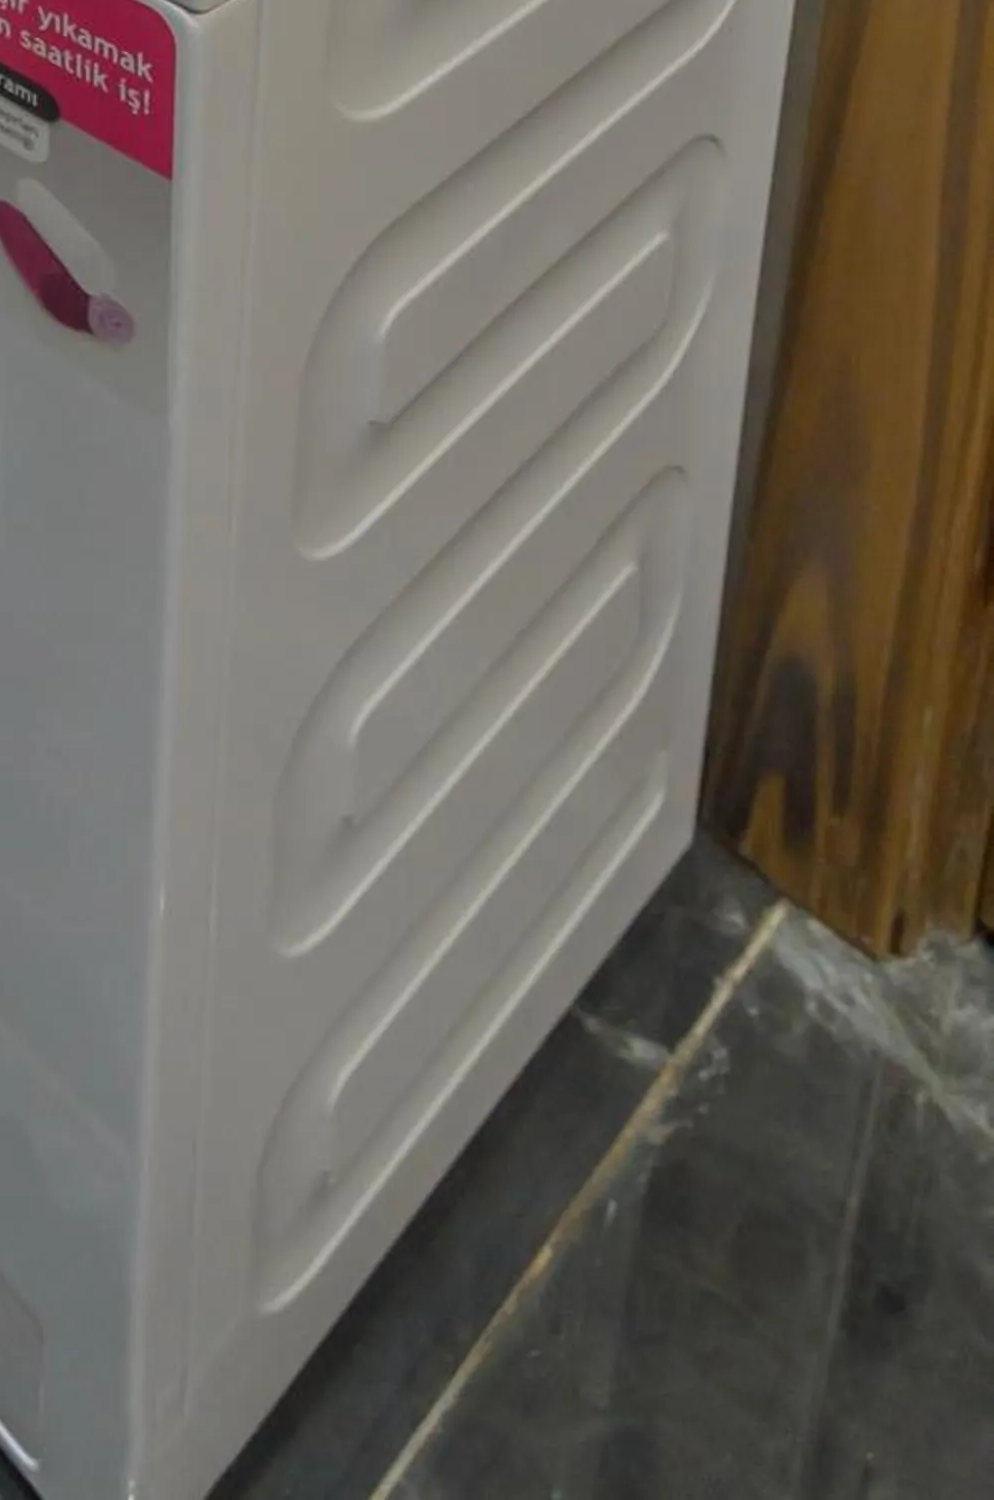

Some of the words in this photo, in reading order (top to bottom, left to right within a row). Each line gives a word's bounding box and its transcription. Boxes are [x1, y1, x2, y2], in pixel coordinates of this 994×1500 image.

[19, 29, 109, 92] saatlik
[118, 77, 151, 115] iş!
[37, 5, 153, 82] yıkamak
